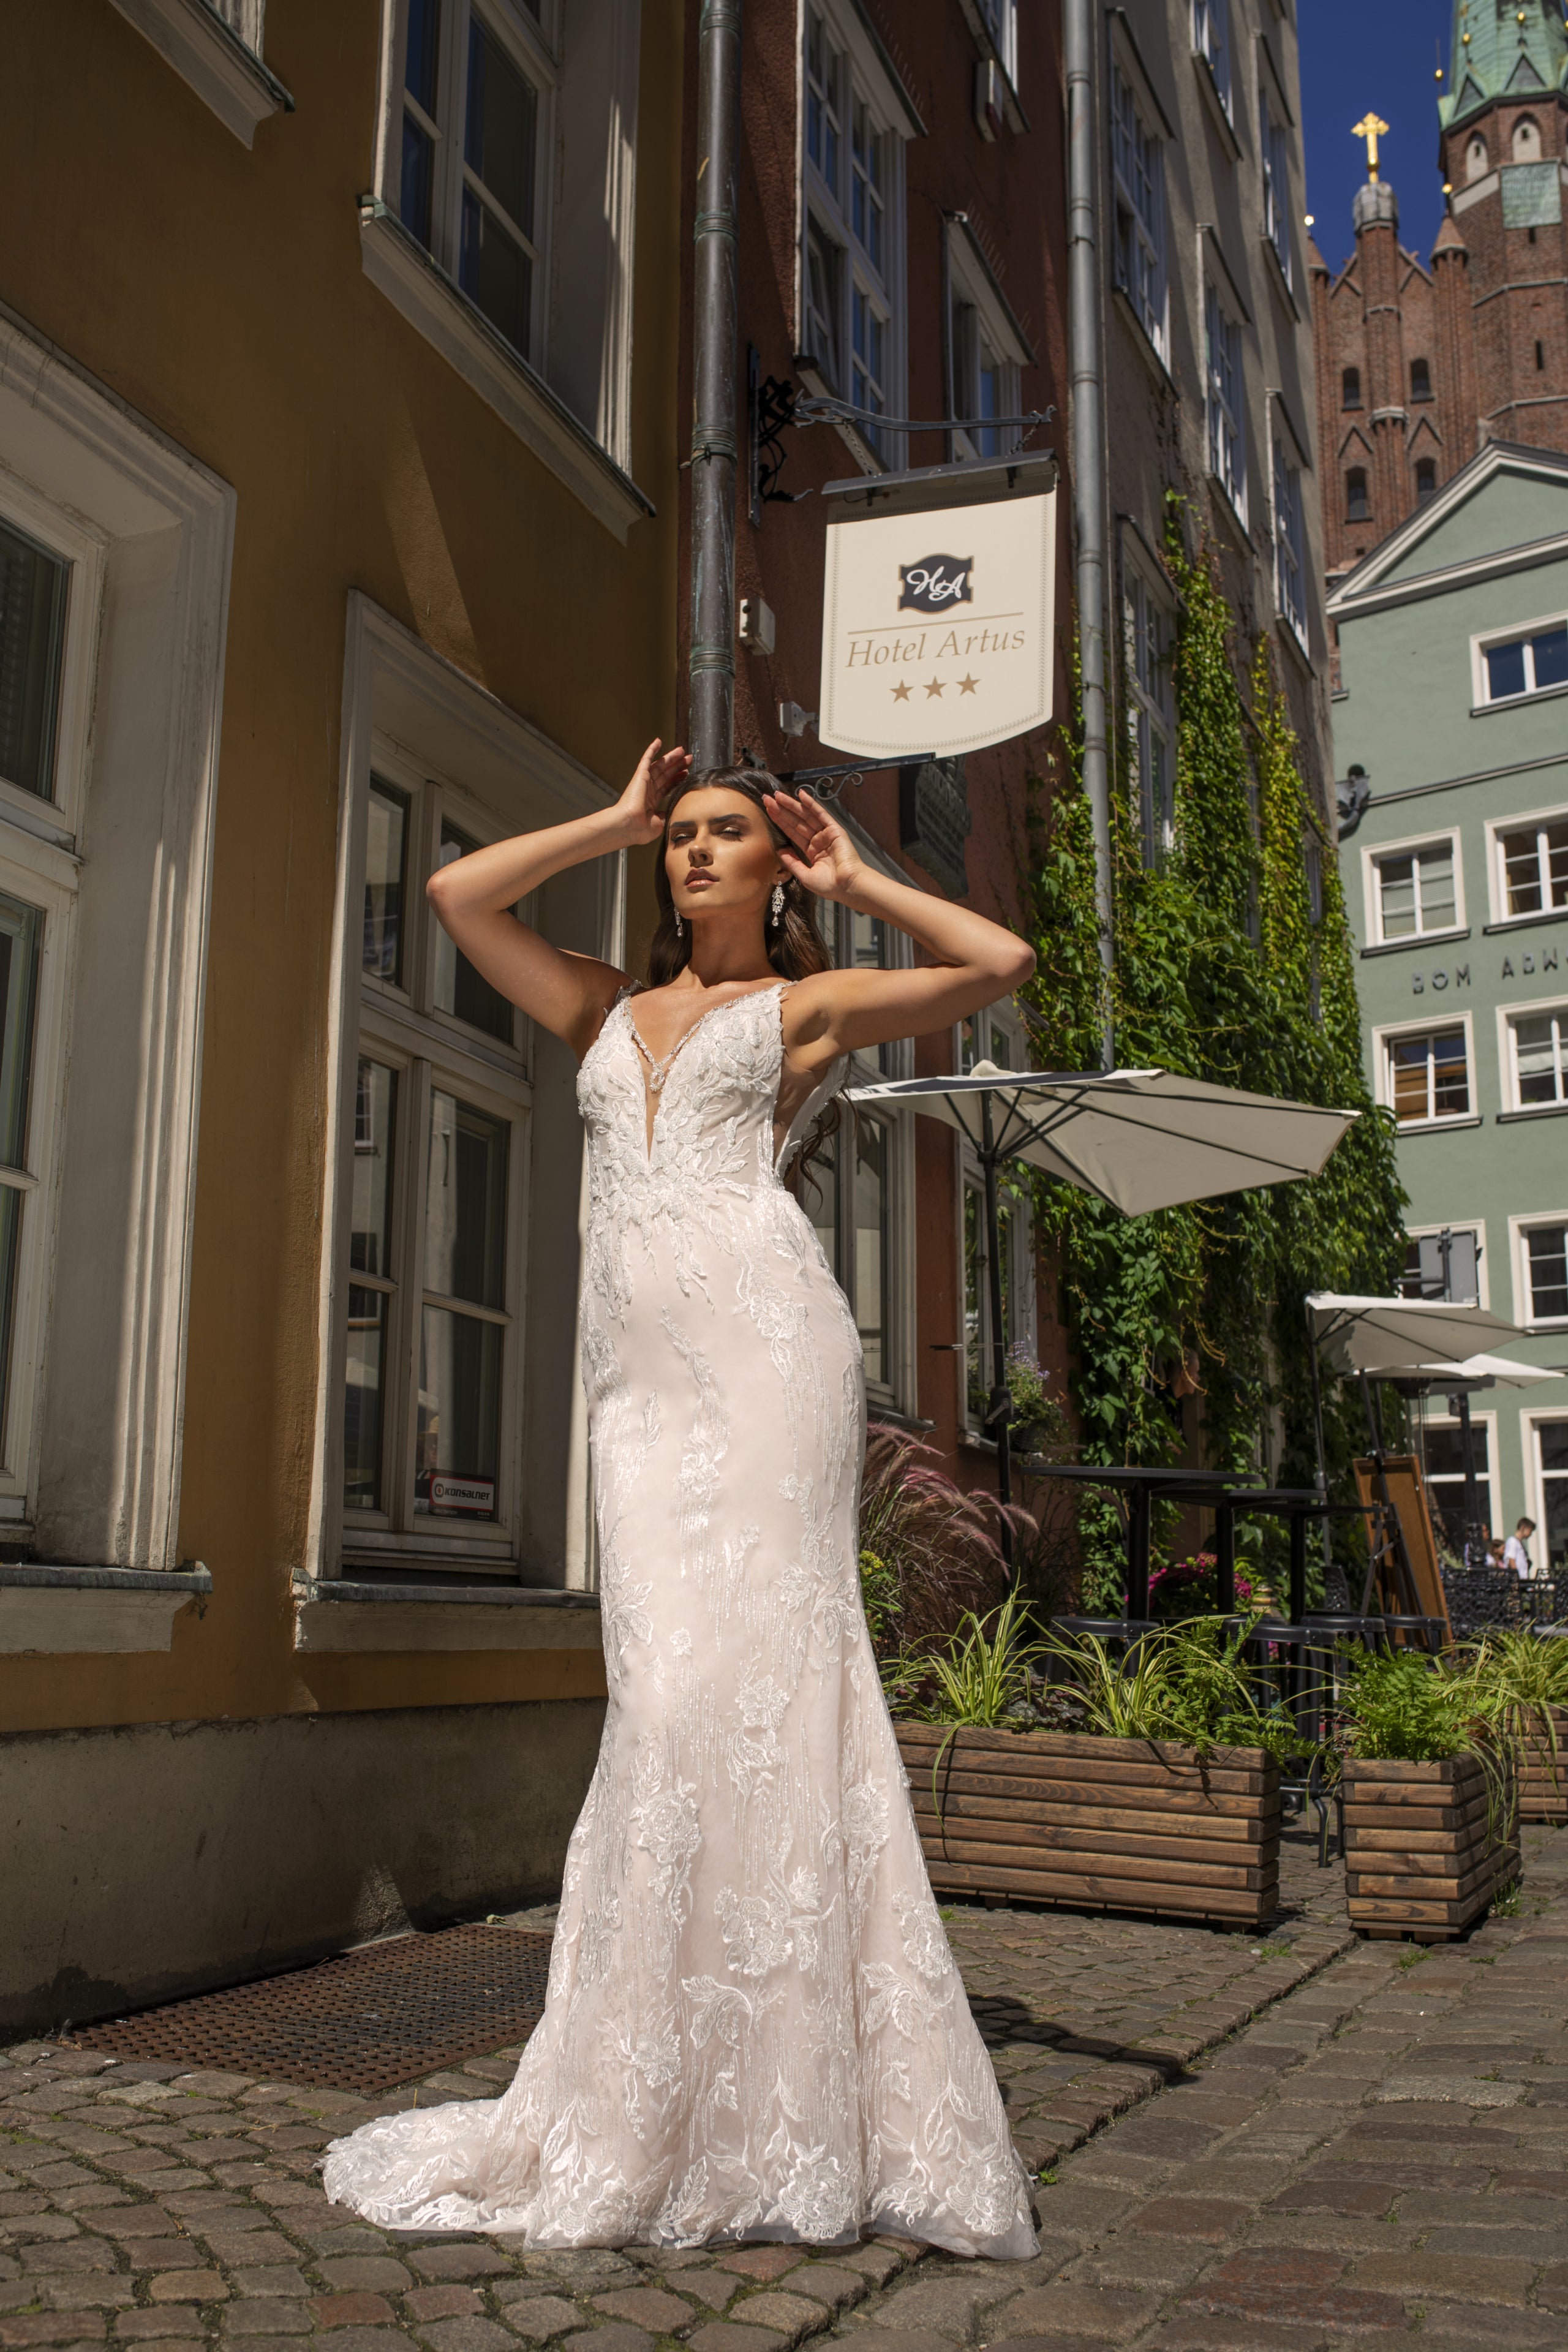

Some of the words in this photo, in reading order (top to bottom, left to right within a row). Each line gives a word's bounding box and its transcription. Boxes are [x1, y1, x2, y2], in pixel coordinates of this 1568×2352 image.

[845, 633, 927, 668] Hotel
[935, 628, 1025, 658] Artus
[1412, 963, 1471, 995] DOM
[1501, 946, 1568, 980] ADW
